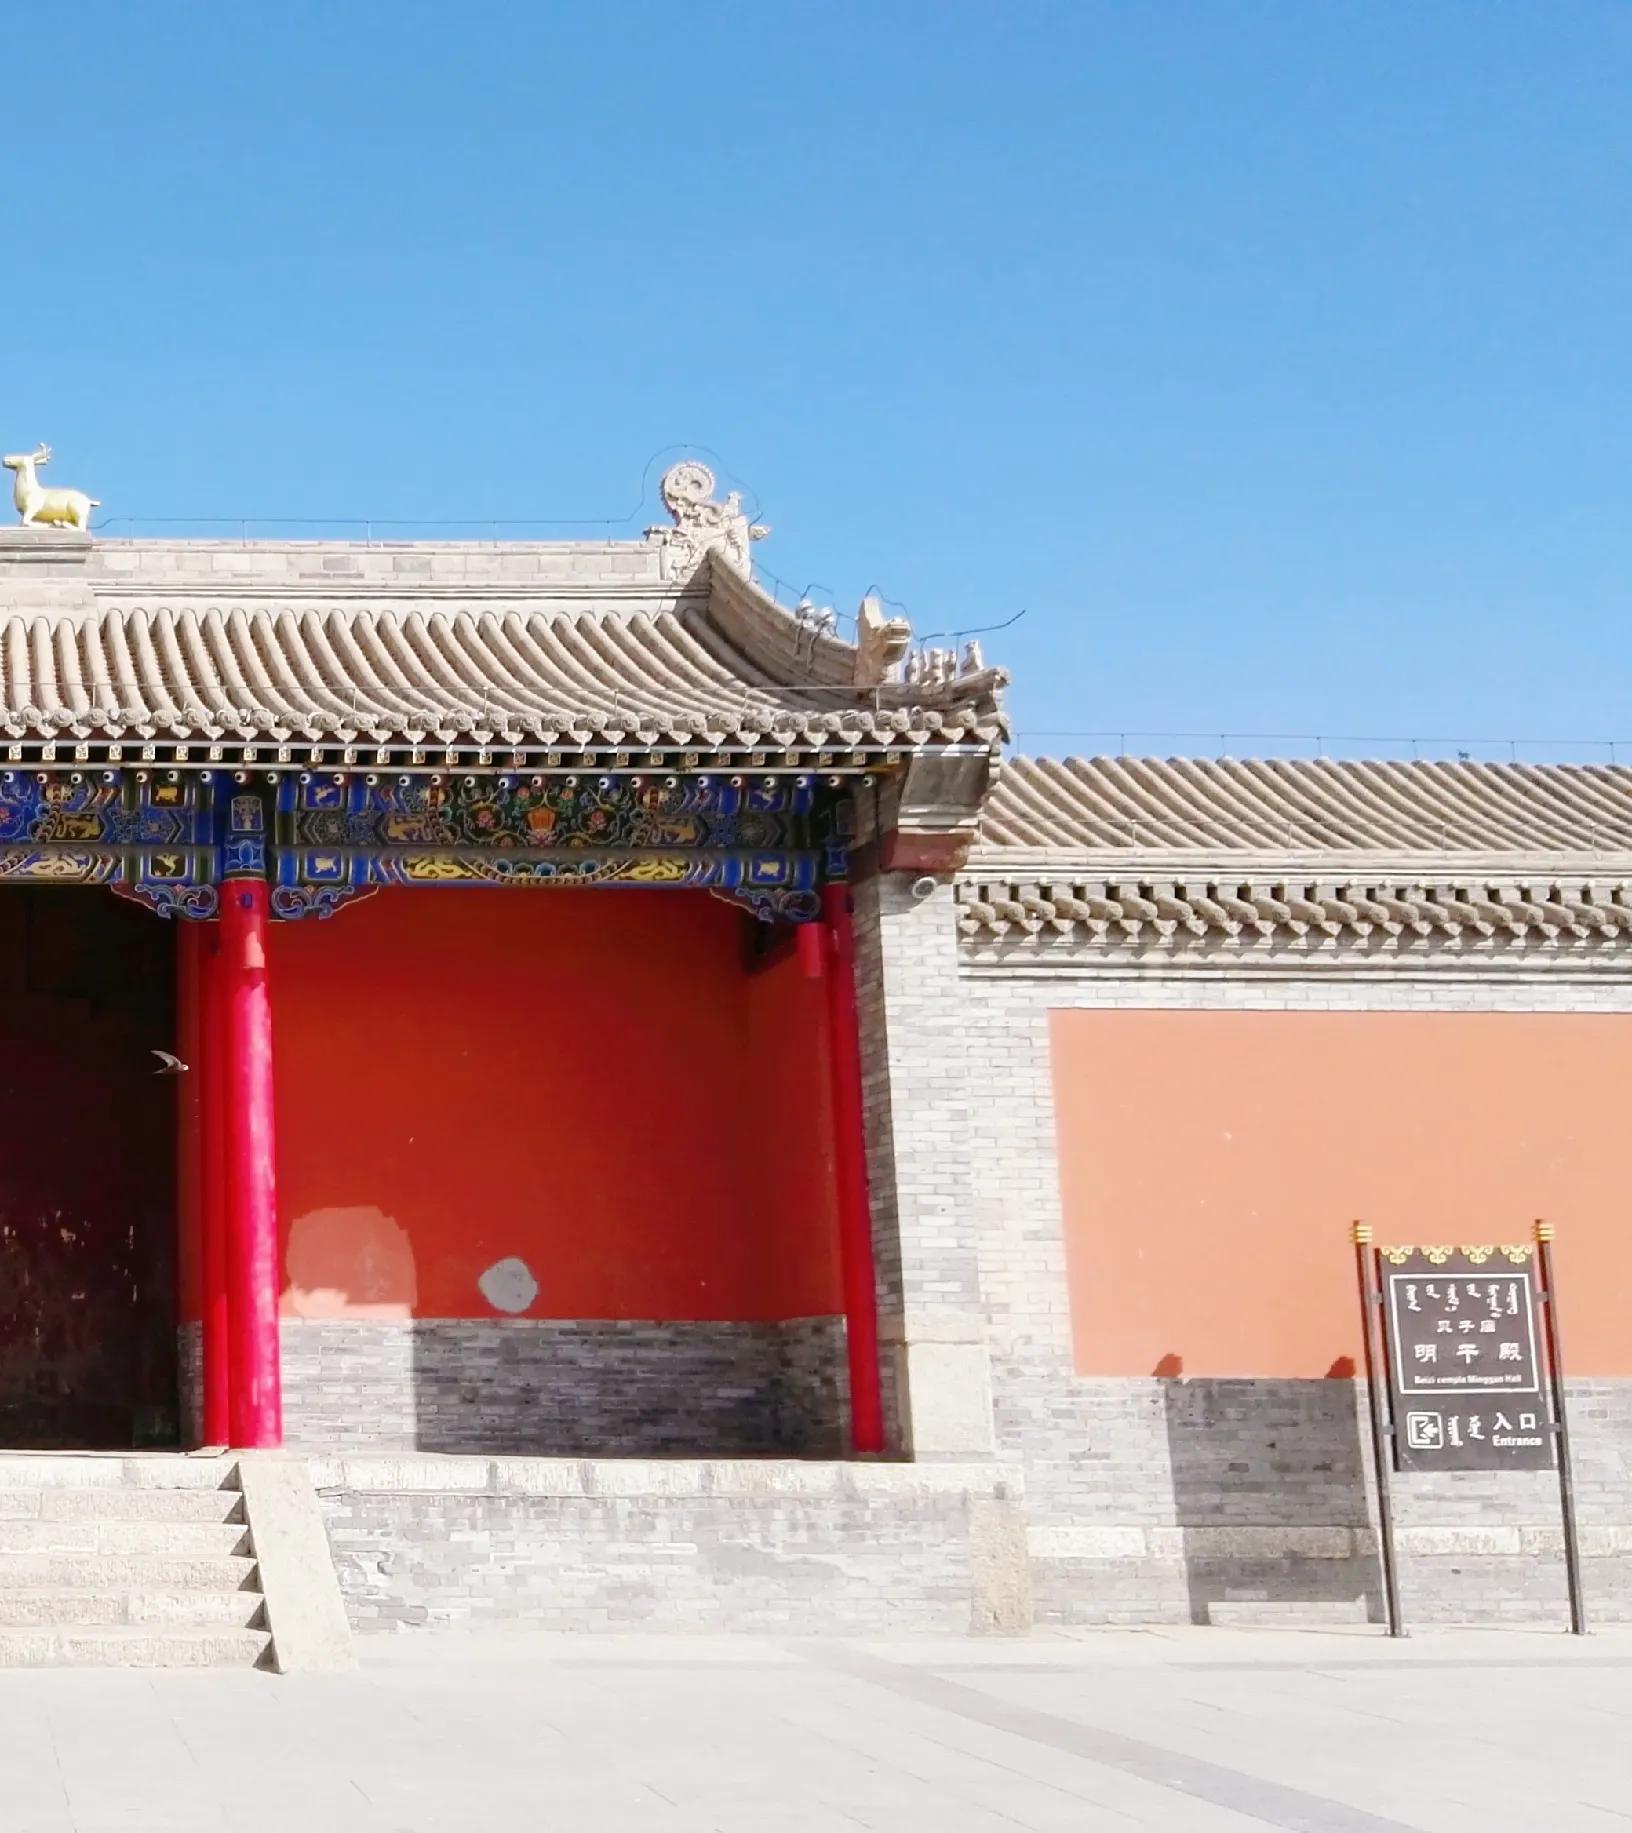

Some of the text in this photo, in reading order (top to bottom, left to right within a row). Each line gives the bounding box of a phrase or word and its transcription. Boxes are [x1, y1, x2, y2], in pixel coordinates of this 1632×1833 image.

[1414, 1342, 1522, 1364] 明干殿
[1493, 1412, 1536, 1430] 入口
[1492, 1434, 1543, 1446] Entrance
